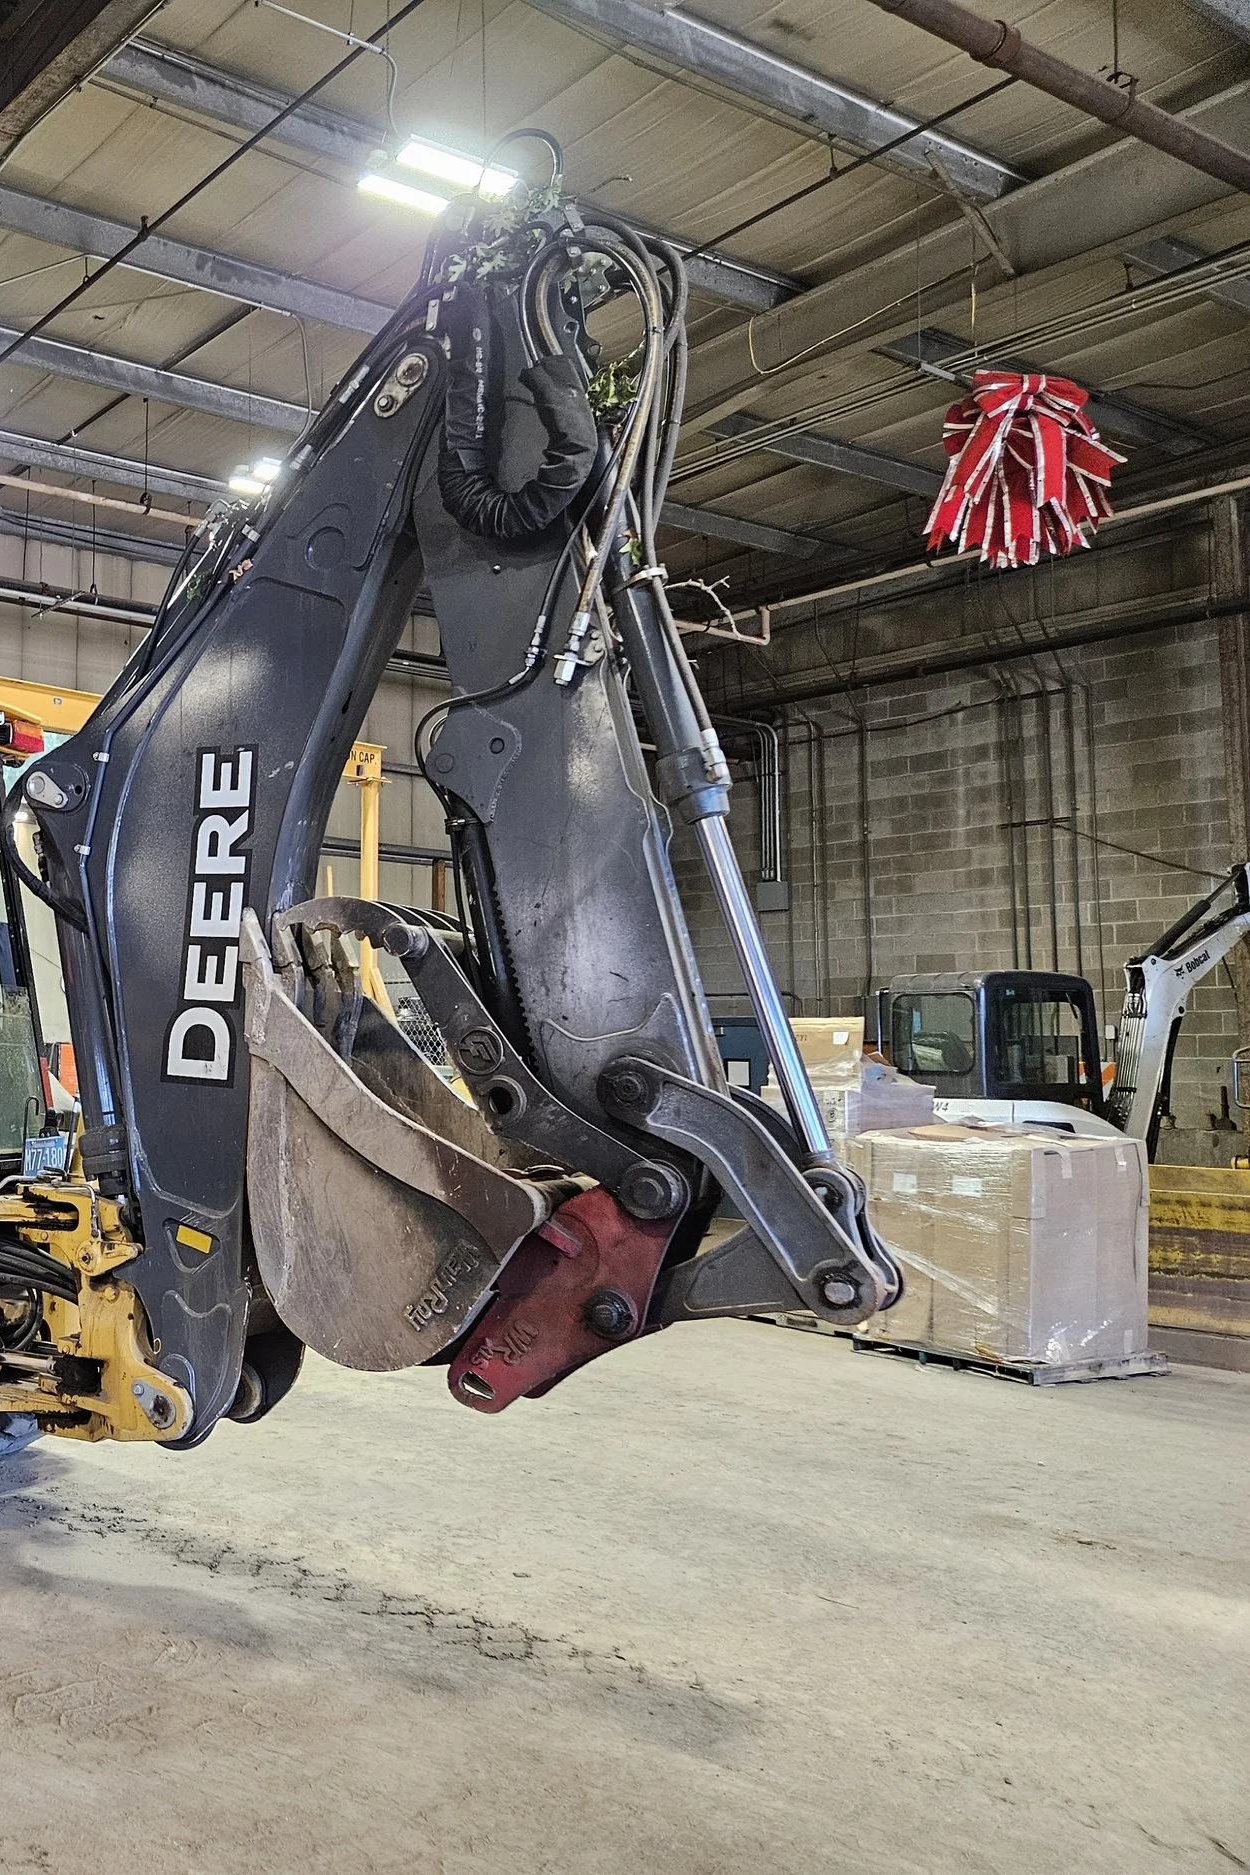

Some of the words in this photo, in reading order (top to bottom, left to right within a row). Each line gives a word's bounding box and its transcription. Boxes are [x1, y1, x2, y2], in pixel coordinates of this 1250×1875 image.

[359, 751, 377, 765] CAP.
[167, 750, 253, 1080] DEERE
[1185, 949, 1211, 973] Bobcat
